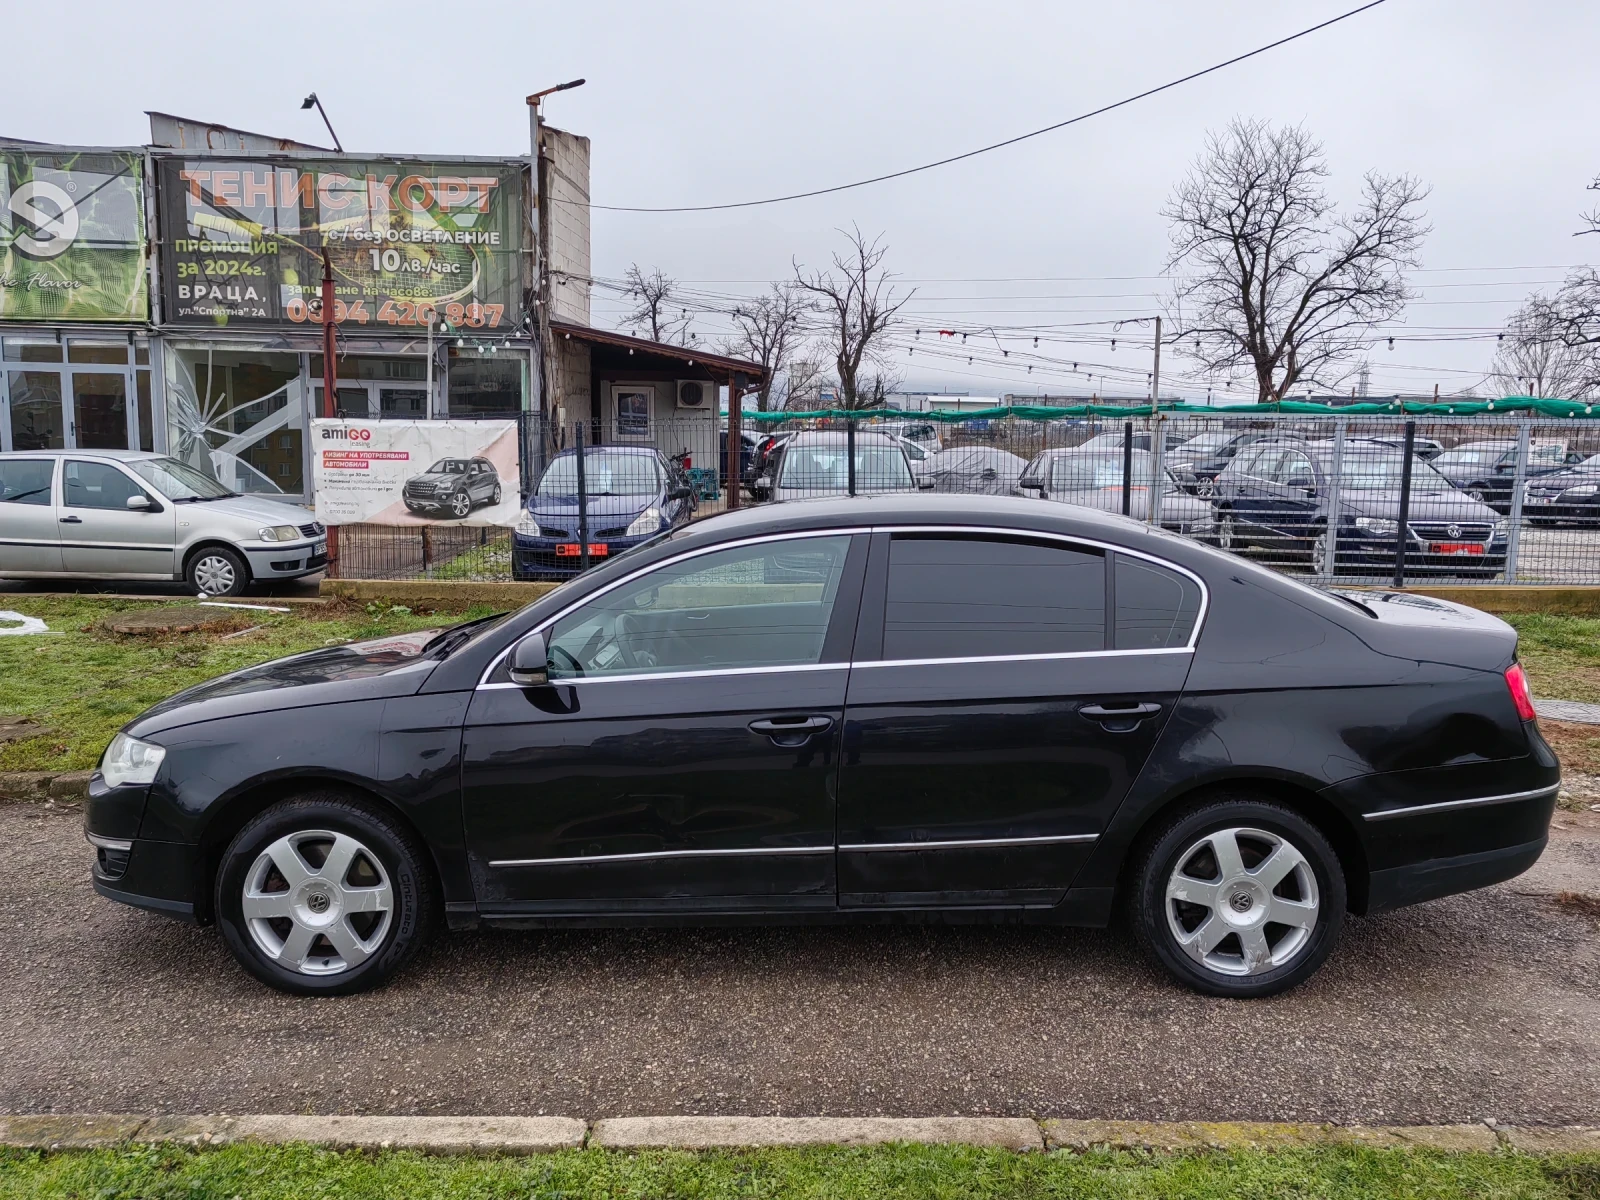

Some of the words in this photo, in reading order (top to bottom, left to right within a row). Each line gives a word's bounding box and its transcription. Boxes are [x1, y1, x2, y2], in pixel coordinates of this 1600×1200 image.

[180, 170, 350, 209] ТЕНИС
[365, 174, 498, 213] КОРТ
[353, 228, 383, 244] без
[386, 228, 501, 245] ОСВЕТЛЕНИЕ
[175, 239, 278, 256] ПРОМОЦИЯ
[177, 261, 199, 277] за
[362, 286, 379, 296] на
[377, 300, 437, 326] 420
[445, 302, 505, 328] 887
[324, 451, 348, 459] ЛИЗИНГ
[324, 460, 368, 468] АВТОМОБИЛИ
[401, 873, 413, 935] Cinturato
